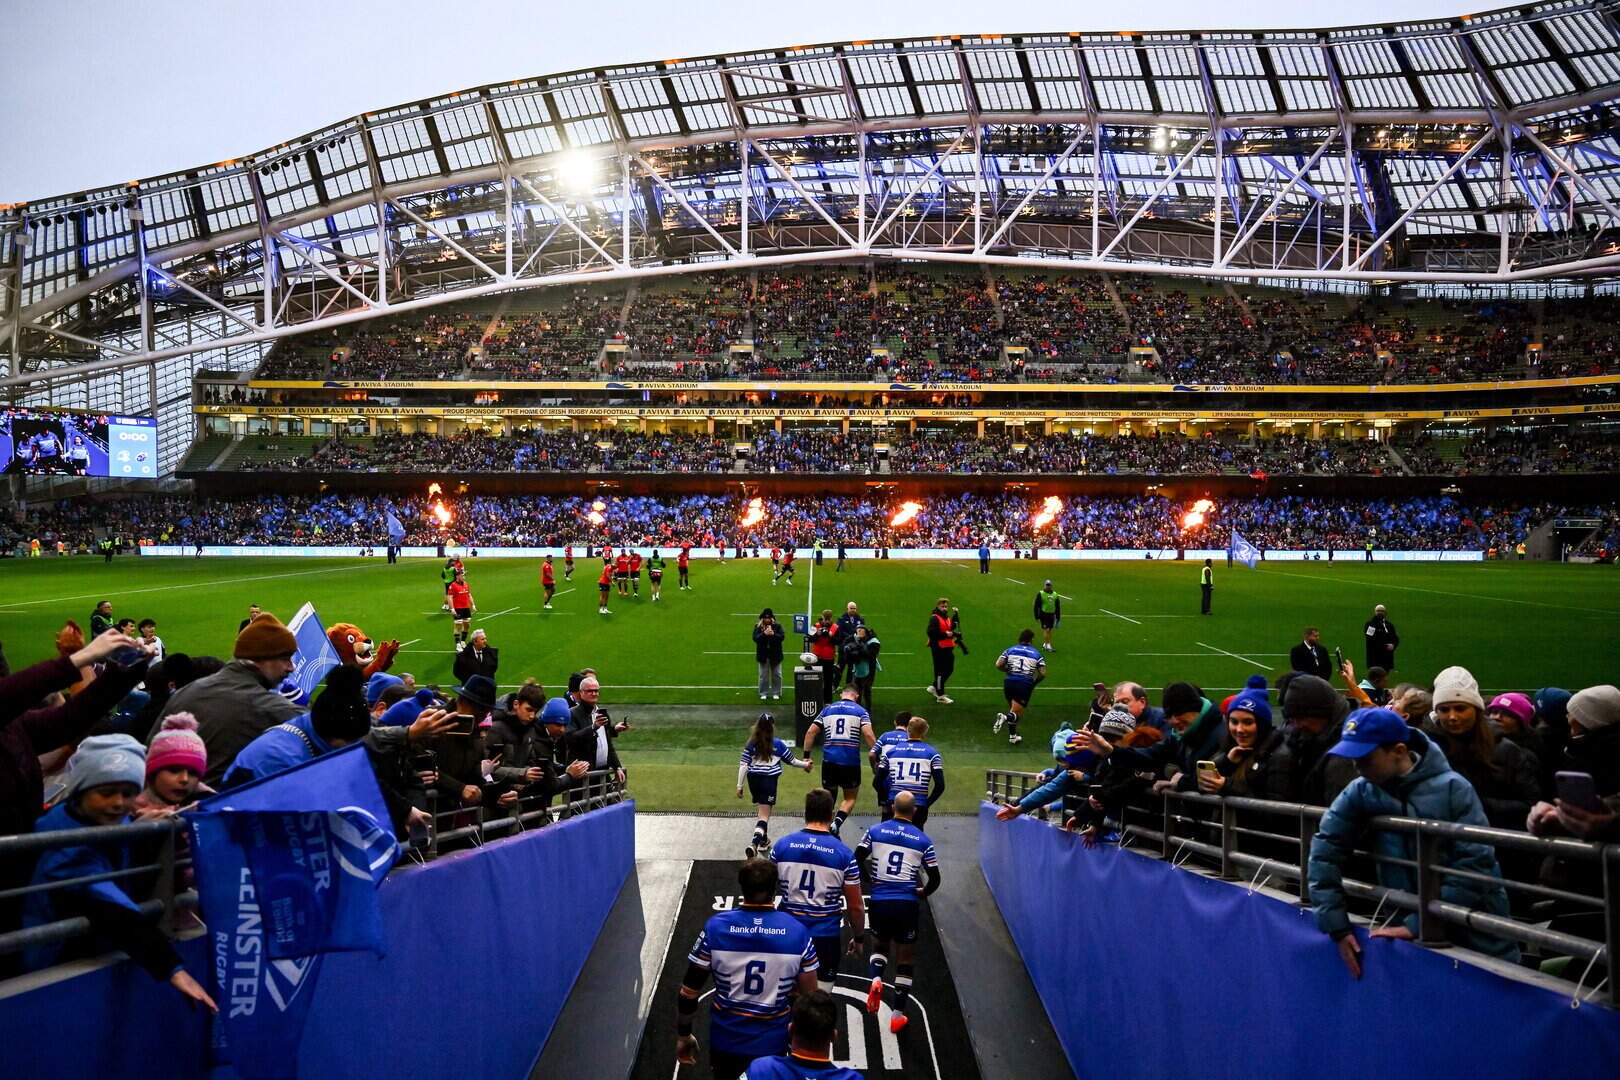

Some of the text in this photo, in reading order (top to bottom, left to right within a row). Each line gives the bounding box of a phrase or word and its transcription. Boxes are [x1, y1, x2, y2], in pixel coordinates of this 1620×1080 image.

[836, 718, 845, 734] 8
[896, 762, 921, 781] 14
[901, 832, 920, 841] Ireland
[812, 844, 834, 854] Ireland
[887, 851, 904, 875] 9
[800, 869, 816, 899] 4
[759, 926, 786, 935] Ireland
[229, 867, 262, 1019] LEINSTER
[215, 931, 228, 990] RUGBY
[744, 960, 766, 995] 6
